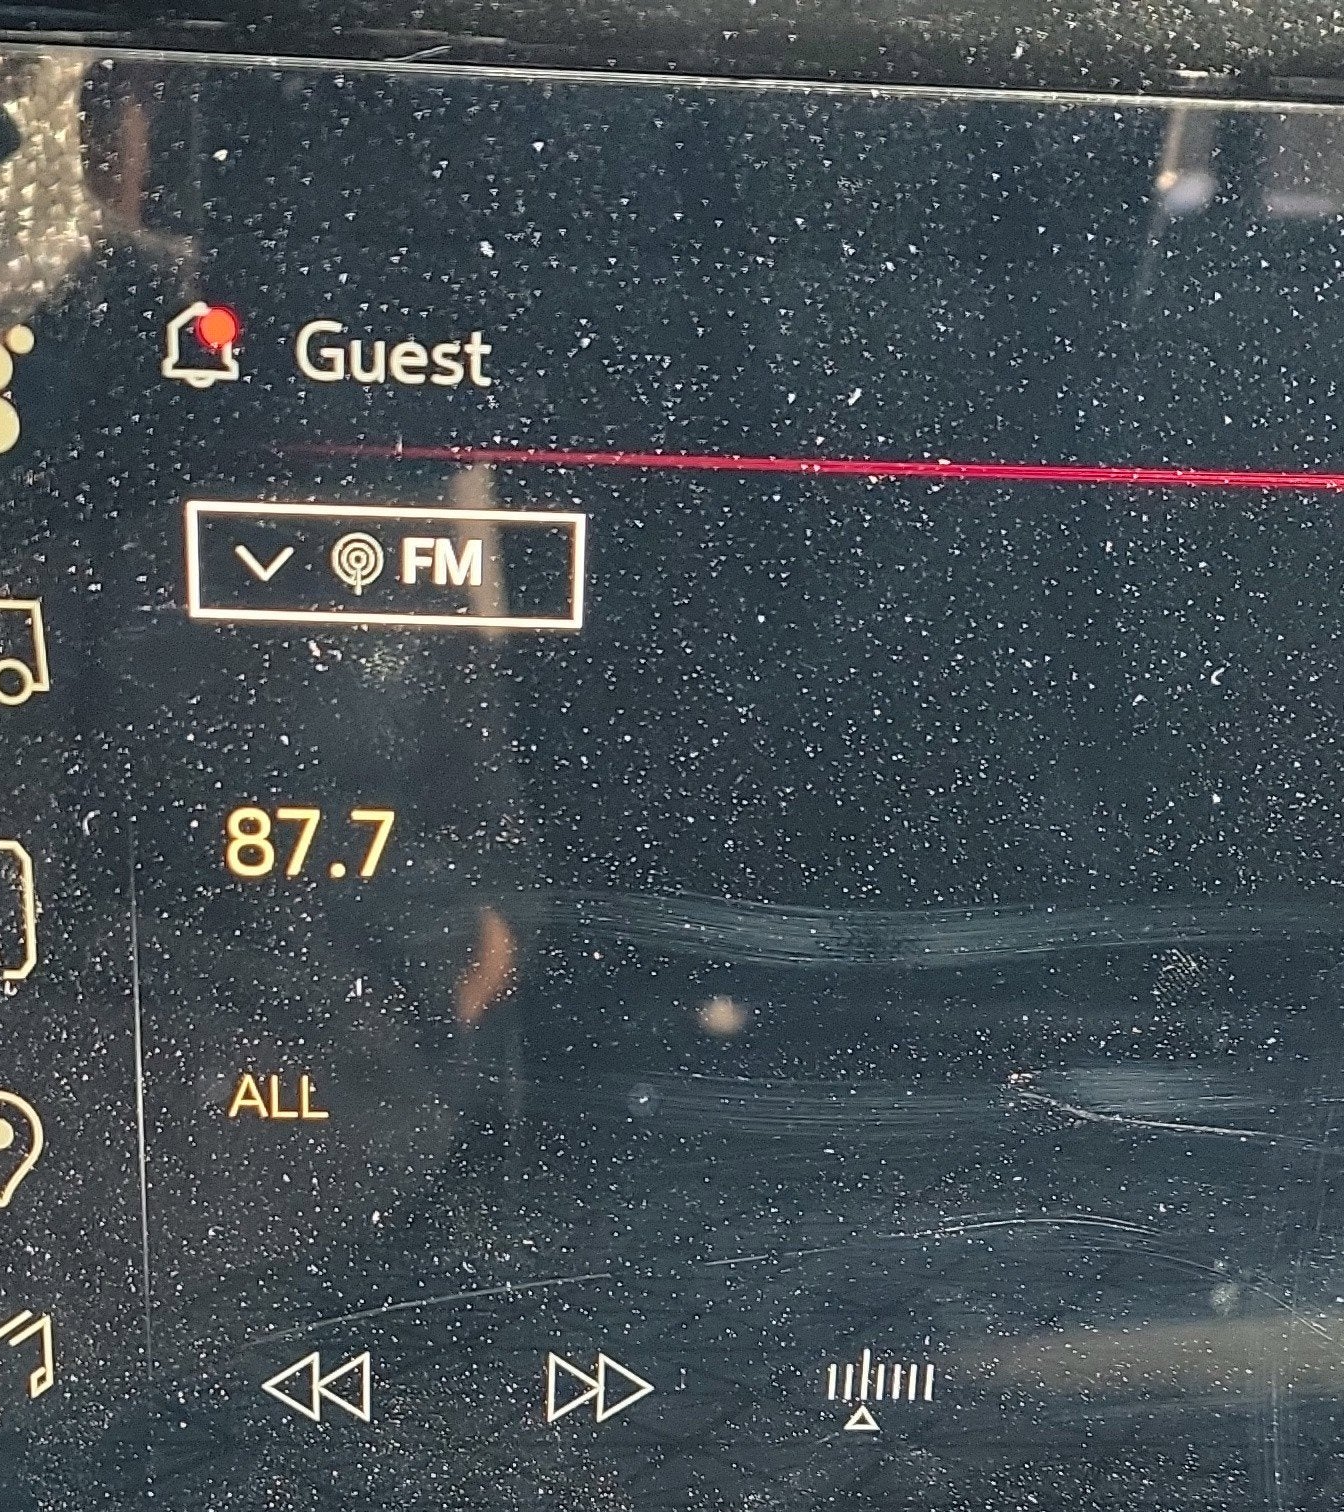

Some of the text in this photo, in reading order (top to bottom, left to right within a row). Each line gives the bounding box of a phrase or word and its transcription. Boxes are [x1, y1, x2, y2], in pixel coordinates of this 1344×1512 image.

[295, 319, 493, 388] Guest
[402, 537, 483, 586] FM
[225, 809, 395, 879] 87.7
[229, 1075, 329, 1119] ALL
